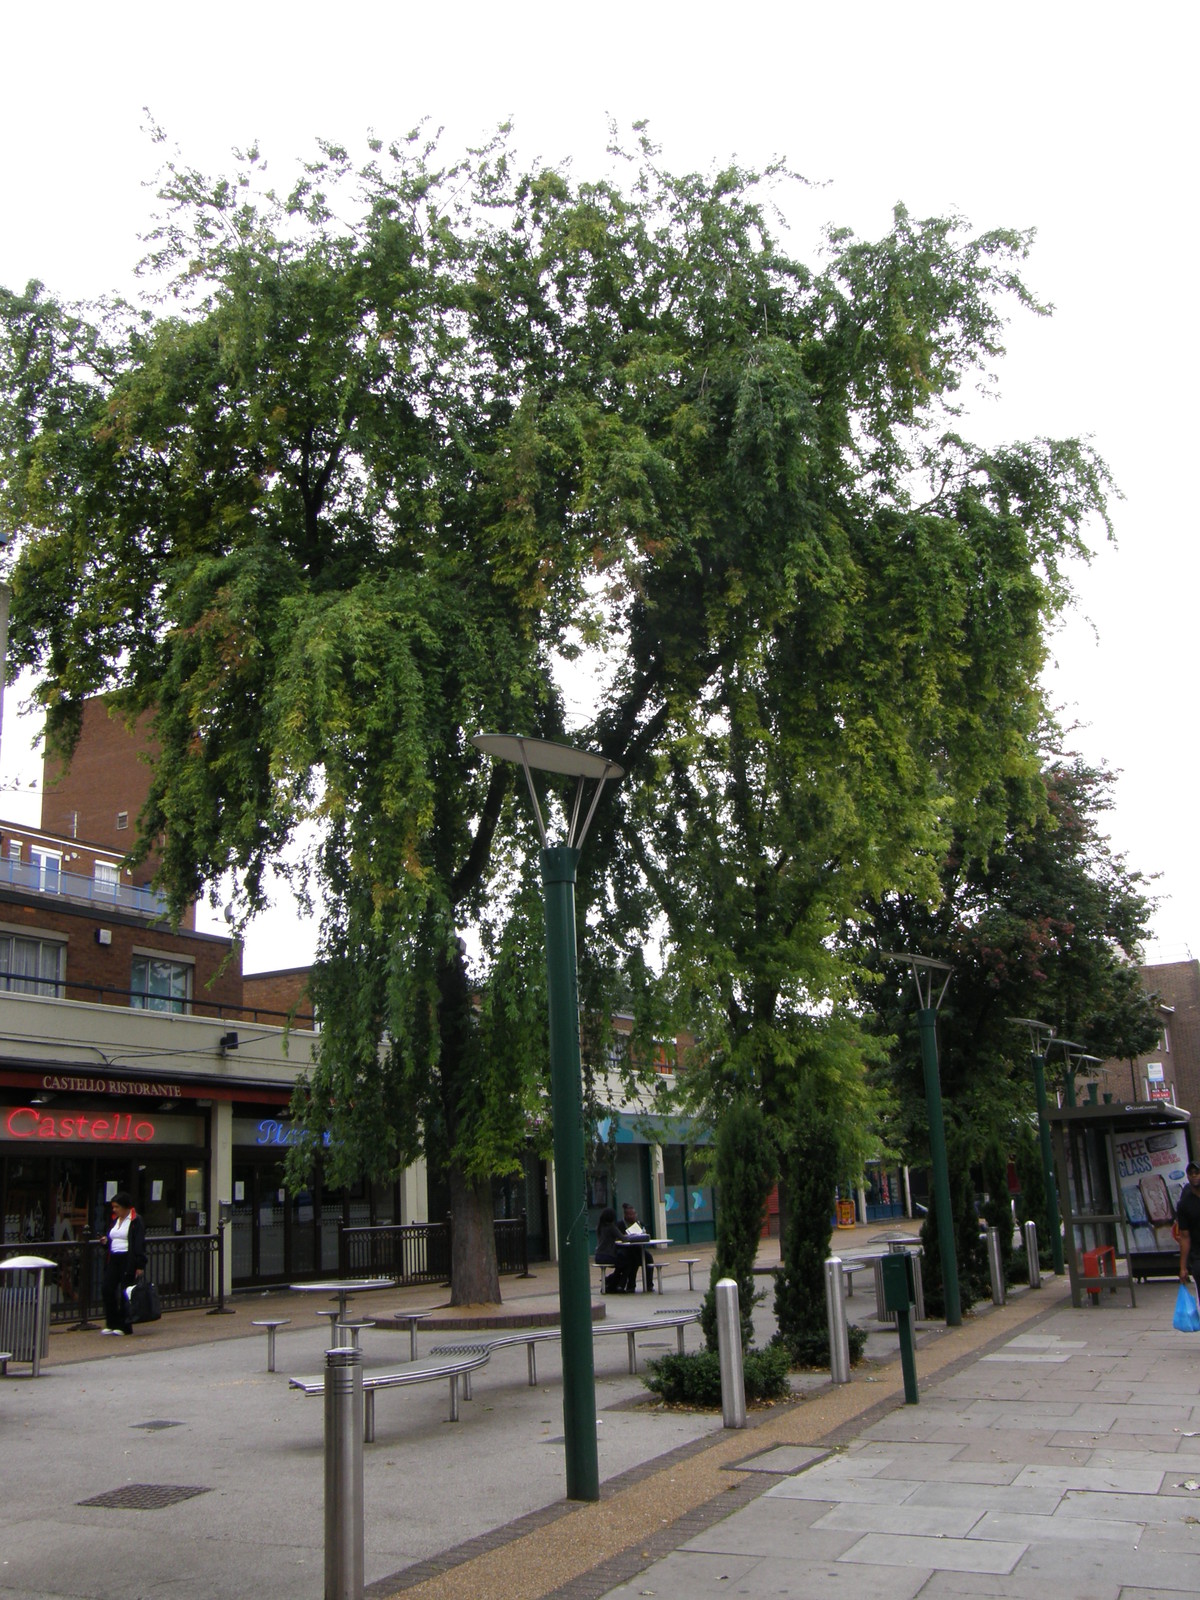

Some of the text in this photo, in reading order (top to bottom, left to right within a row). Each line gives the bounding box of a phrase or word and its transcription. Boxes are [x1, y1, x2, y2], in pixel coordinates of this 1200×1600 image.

[42, 1075, 182, 1097] CASTELLO RISTORANTE
[7, 1107, 155, 1142] Castello
[1118, 1155, 1152, 1177] GLASS
